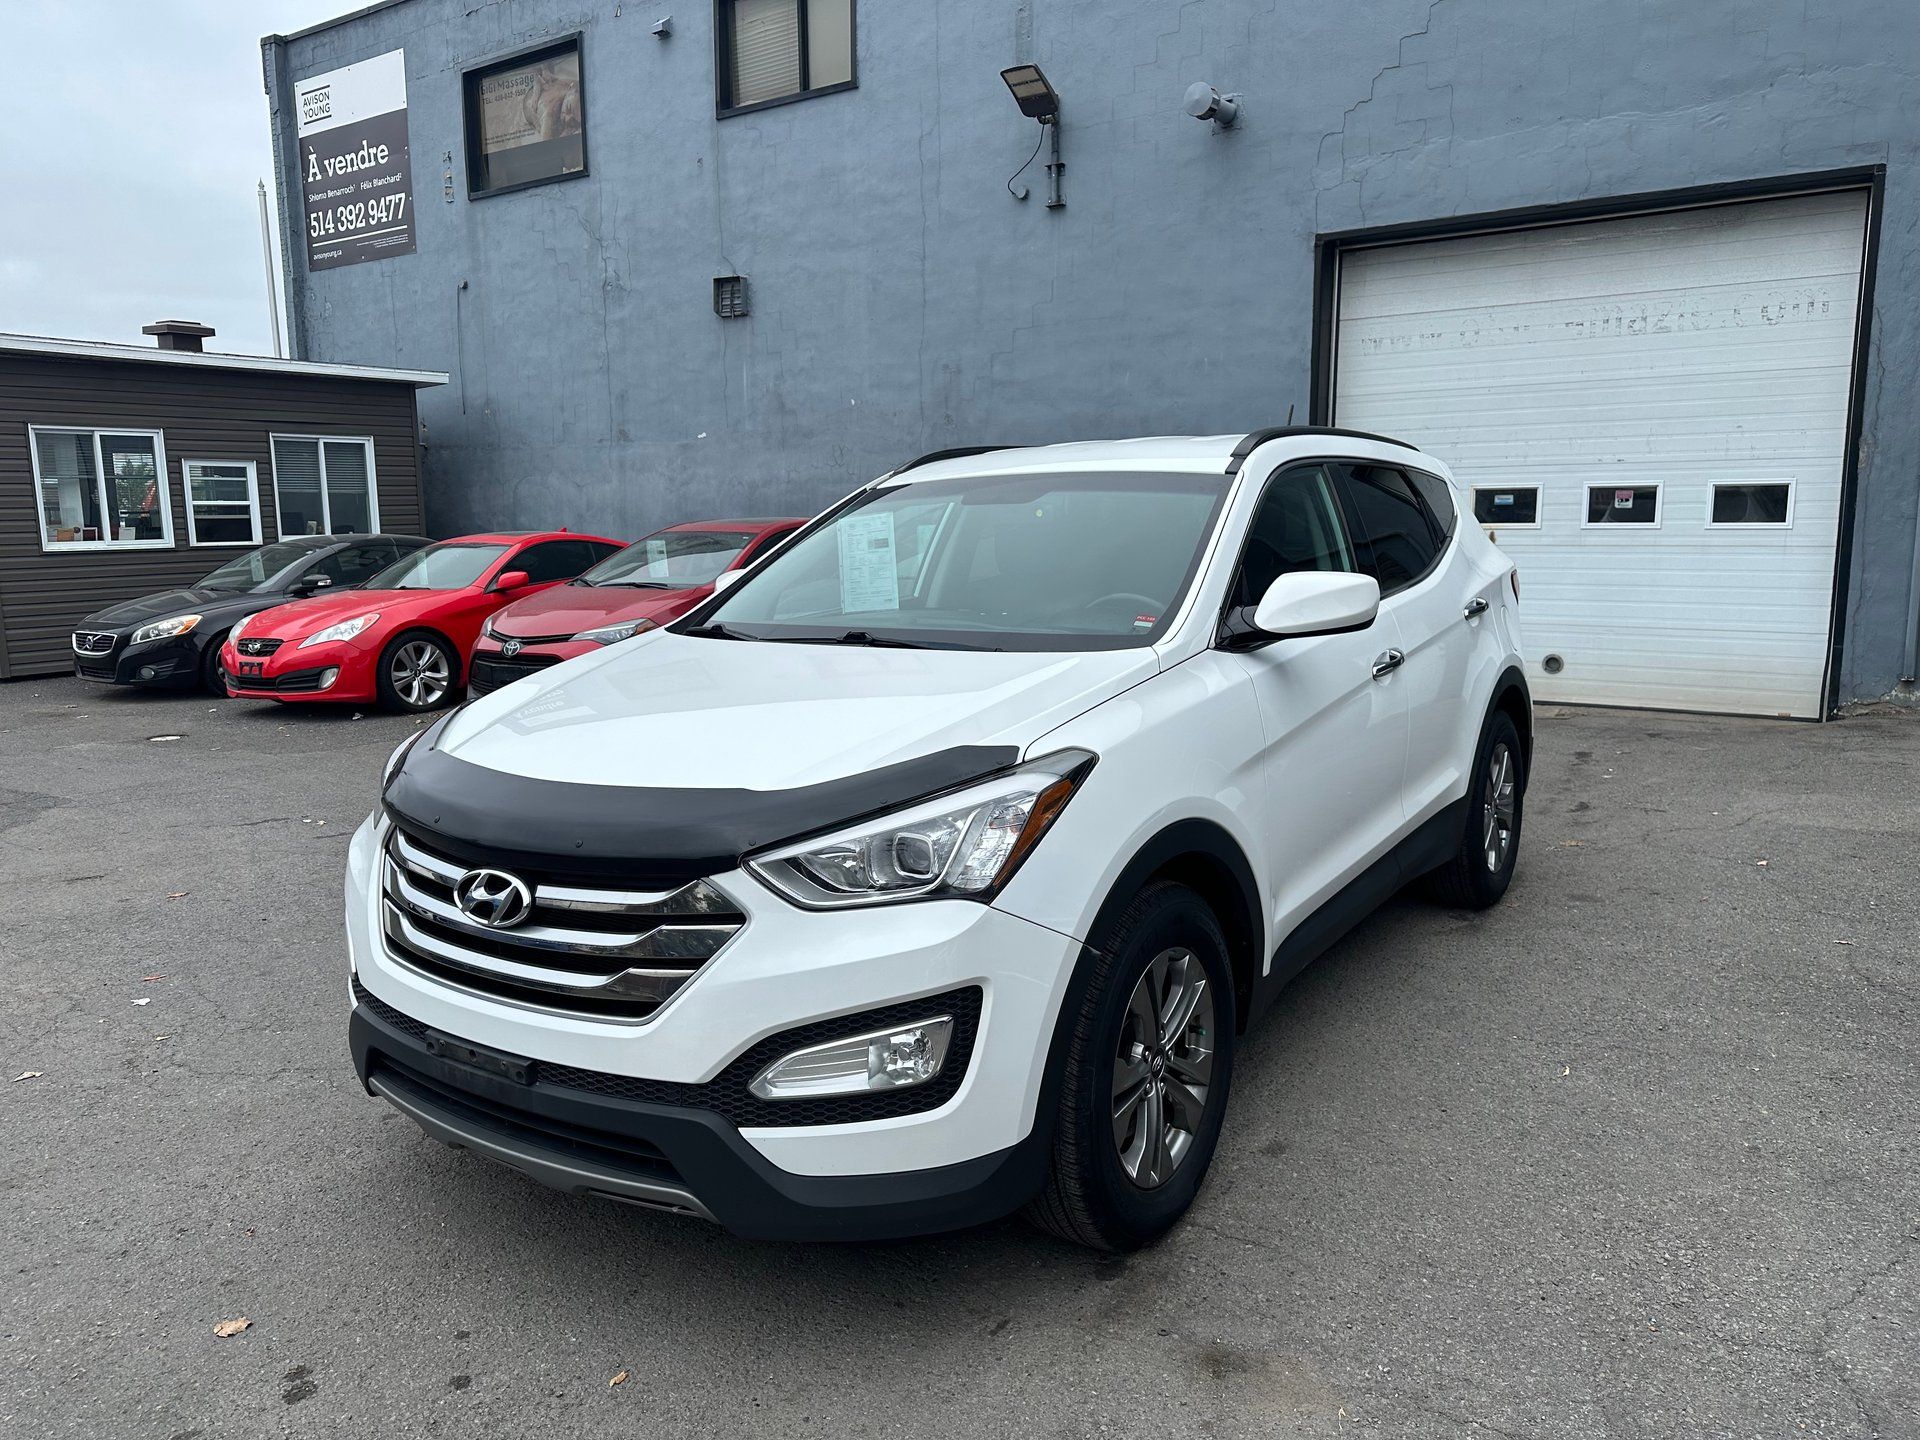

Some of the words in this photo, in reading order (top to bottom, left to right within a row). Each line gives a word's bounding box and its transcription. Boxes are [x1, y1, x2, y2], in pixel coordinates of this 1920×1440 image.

[497, 74, 534, 89] Massage
[303, 91, 330, 108] AVISON
[303, 103, 331, 119] YOUNG
[308, 146, 322, 182] À
[324, 139, 389, 178] vendre
[308, 190, 327, 203] Shlomo
[360, 180, 372, 190] Félix
[310, 208, 335, 238] 514
[336, 202, 366, 232] 392
[367, 192, 406, 226] 9477
[313, 249, 342, 261] avisonyoung.ca
